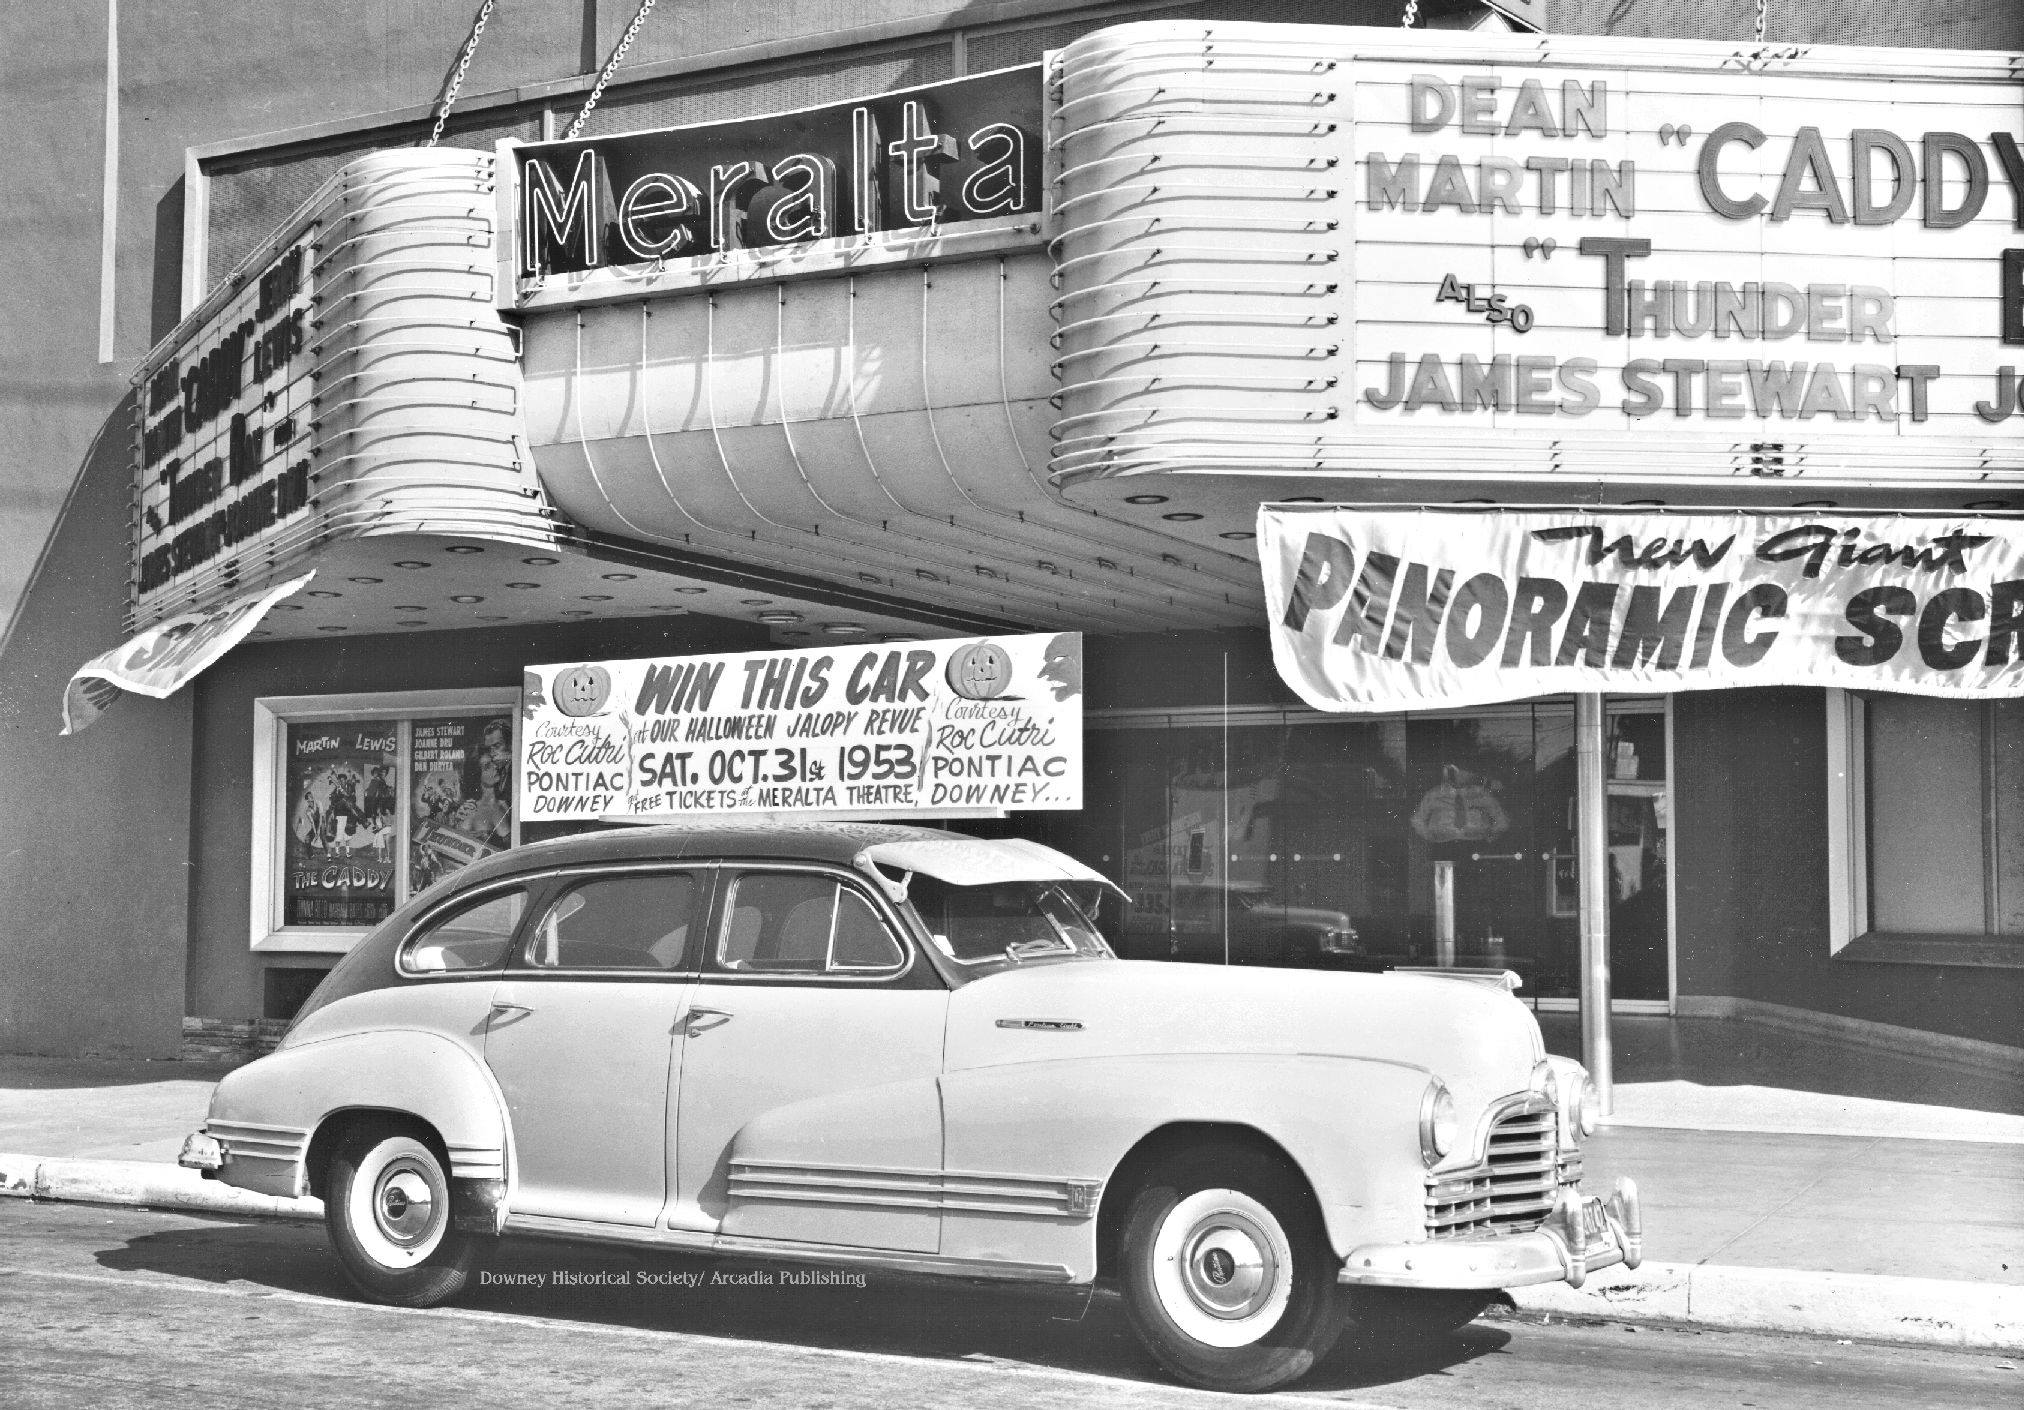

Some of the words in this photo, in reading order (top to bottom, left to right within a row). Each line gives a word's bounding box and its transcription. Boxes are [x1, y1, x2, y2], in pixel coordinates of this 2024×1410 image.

[1412, 73, 1608, 138] DEAN
[525, 101, 1024, 272] Meralta
[1367, 151, 1635, 219] MARTIN
[1436, 273, 1535, 335] ALSO
[1365, 352, 1600, 414] JAMES
[1621, 358, 1941, 424] STEWART
[1756, 524, 1991, 580] Giant
[1283, 532, 1788, 670] PANORAMIC
[634, 662, 726, 716] WIN
[741, 656, 834, 711] THIS
[845, 650, 936, 706] CAR
[535, 718, 601, 743] Courtesy
[650, 719, 681, 743] OUR
[685, 714, 777, 743] HALLOWEEN
[787, 711, 859, 738] JALOPY
[863, 707, 927, 735] REVUE
[945, 698, 1024, 726] Courtesy
[296, 736, 341, 756] MARTIN
[355, 733, 397, 752] LEWIS
[415, 727, 436, 738] JAMES
[436, 725, 466, 737] STEWART
[936, 724, 976, 755] Roc
[980, 716, 1056, 749] Cutri
[526, 740, 563, 771] Roc
[564, 734, 627, 766] Cutri
[638, 752, 699, 788] SAT.
[838, 743, 917, 782] 1953
[931, 754, 1068, 779] PONTIAC
[526, 771, 625, 793] PONTIAC
[634, 793, 662, 815] FREE
[665, 790, 737, 810] TICKETS
[757, 784, 838, 808] MERALTA
[533, 794, 614, 814] DOWNEY
[293, 871, 318, 889] THE
[321, 865, 396, 890] CADDY
